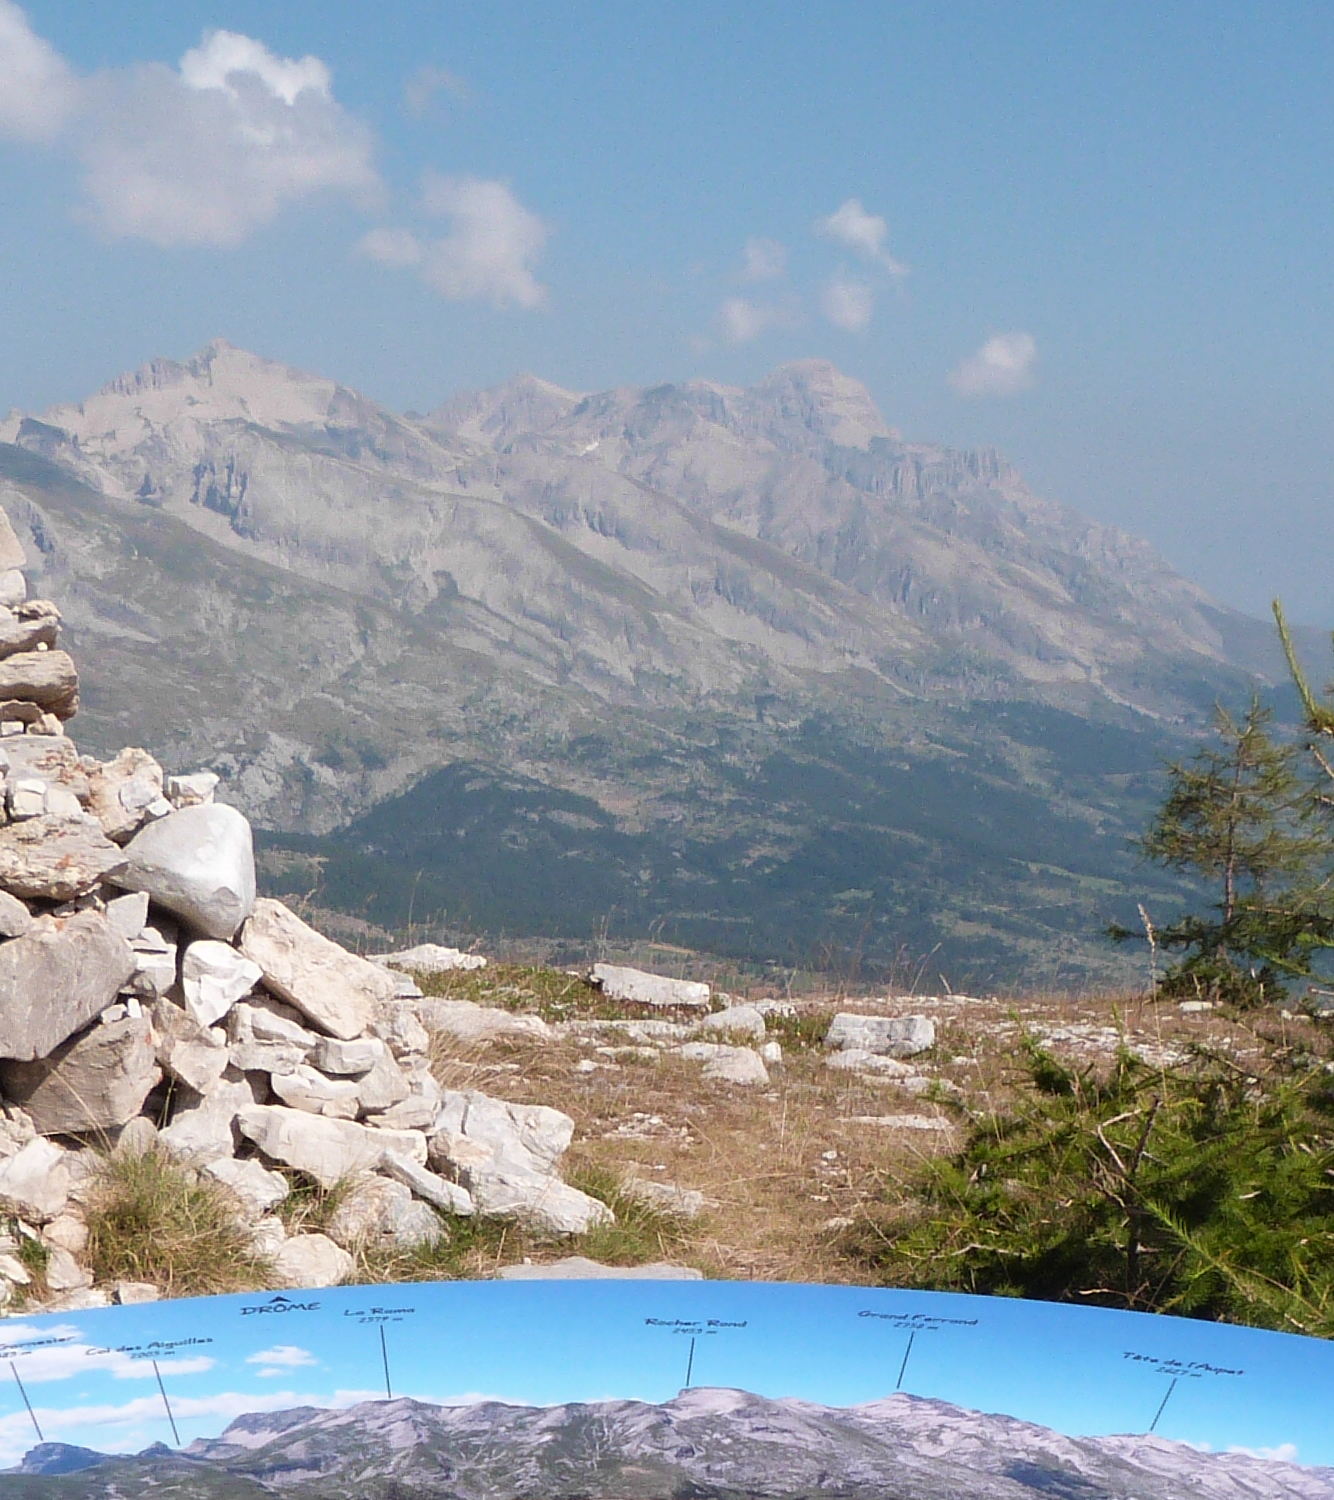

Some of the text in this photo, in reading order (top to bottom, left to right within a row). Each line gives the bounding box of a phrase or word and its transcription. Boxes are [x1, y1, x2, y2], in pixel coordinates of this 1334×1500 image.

[858, 1310, 979, 1325] Grand Ferrand
[86, 1347, 110, 1355] Col
